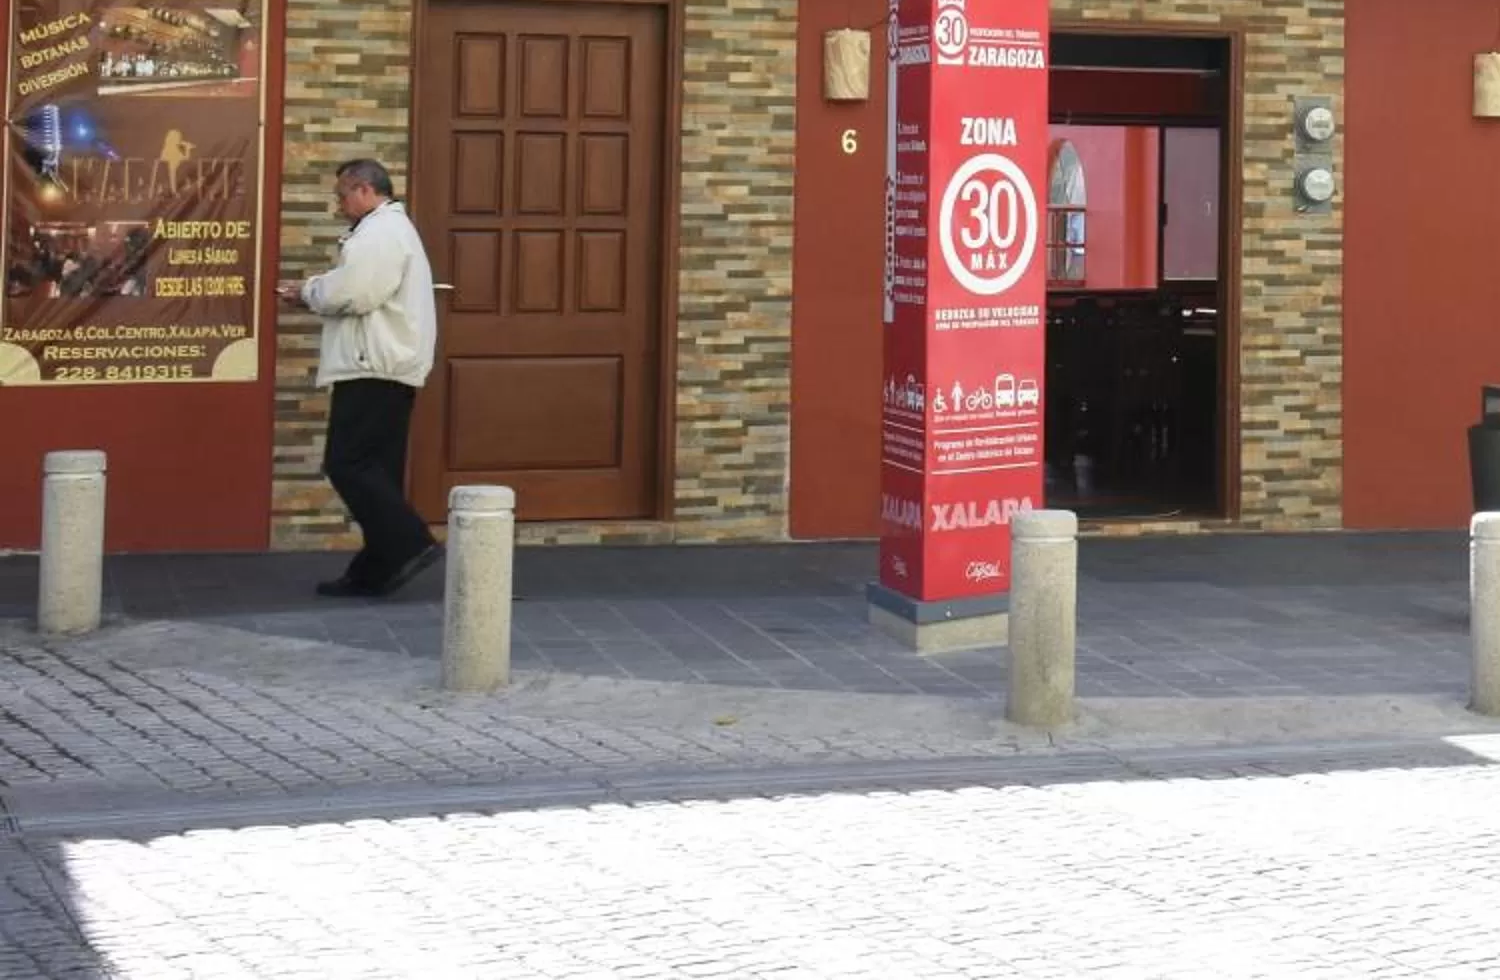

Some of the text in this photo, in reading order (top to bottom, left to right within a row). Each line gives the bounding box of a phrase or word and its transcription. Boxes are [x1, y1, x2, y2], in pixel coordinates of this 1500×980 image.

[938, 16, 964, 46] 30
[20, 35, 90, 69] BOTANAS
[968, 46, 1045, 69] ZARAGOZA
[18, 61, 89, 96] DIVERSIÓN
[842, 129, 857, 154] 6
[960, 117, 1017, 146] ZONA
[153, 217, 222, 239] ABIERTO
[961, 179, 1018, 248] 30
[4, 327, 73, 341] ZARAGOZA
[43, 345, 207, 360] RESERVACIONES:
[931, 496, 1033, 531] XALAPA
